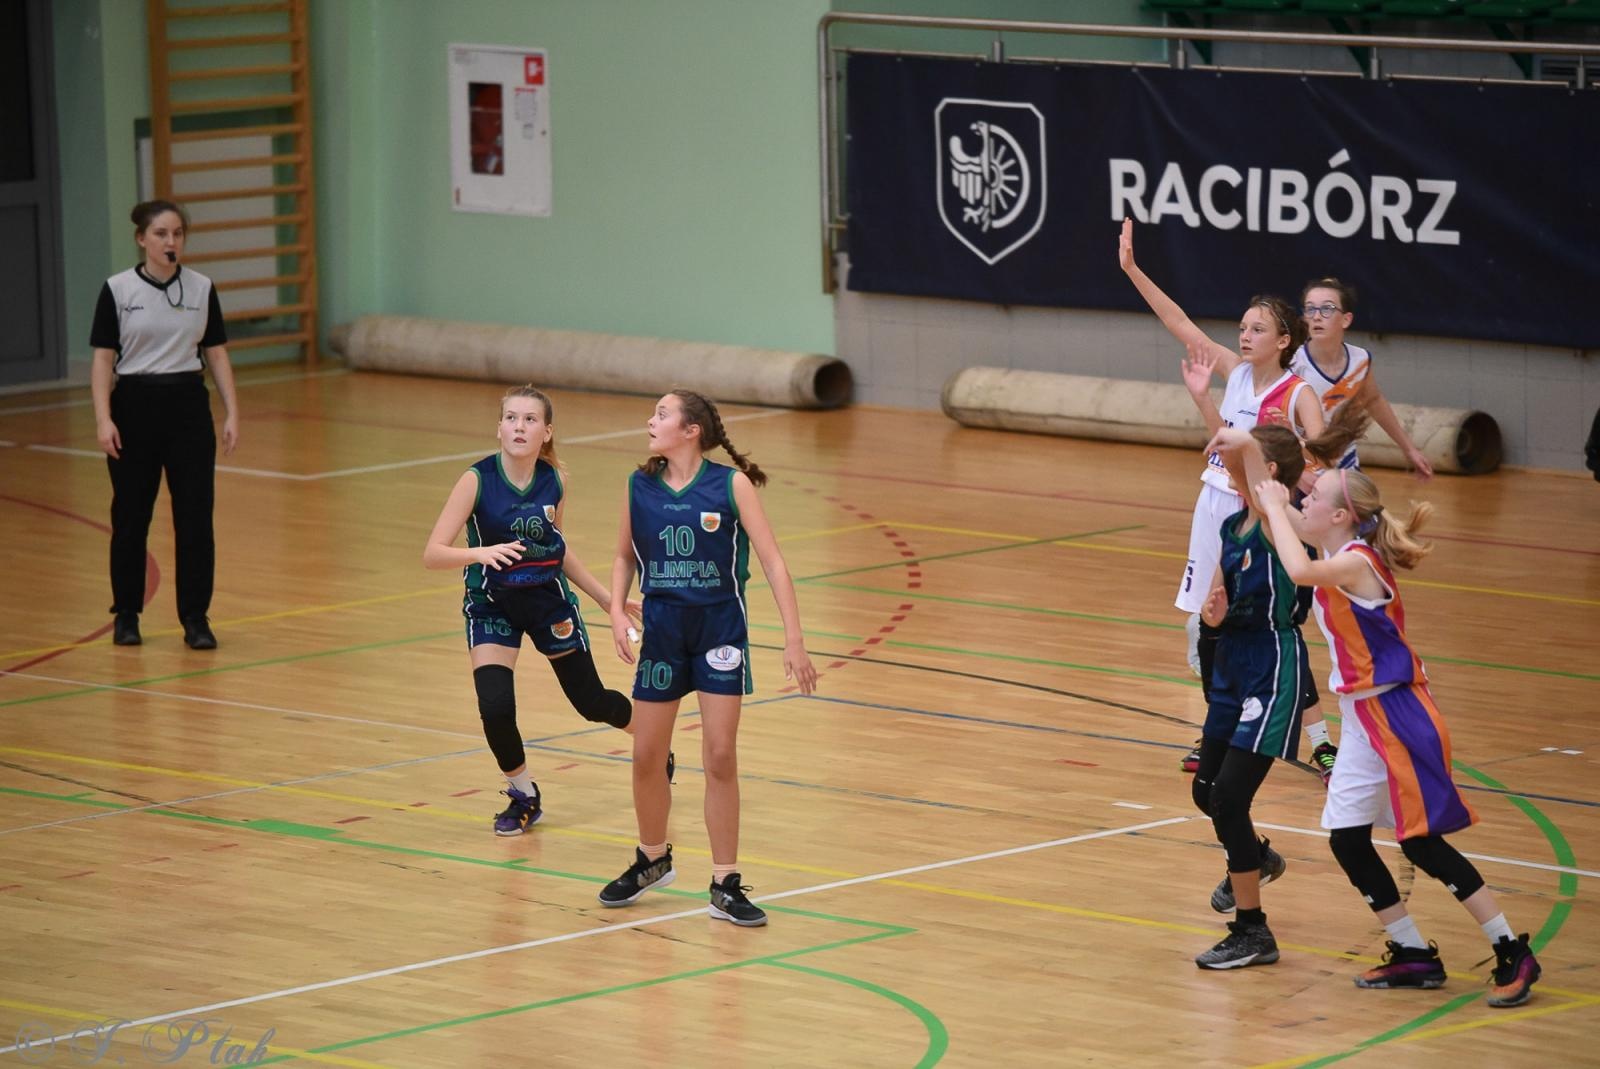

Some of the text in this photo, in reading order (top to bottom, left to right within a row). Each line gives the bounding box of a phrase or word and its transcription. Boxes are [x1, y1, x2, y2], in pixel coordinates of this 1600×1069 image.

[1109, 148, 1461, 246] RACIBÓRZ
[510, 515, 544, 541] 16
[659, 525, 695, 556] 10
[649, 559, 720, 578] LIMPIA
[639, 659, 672, 690] 10
